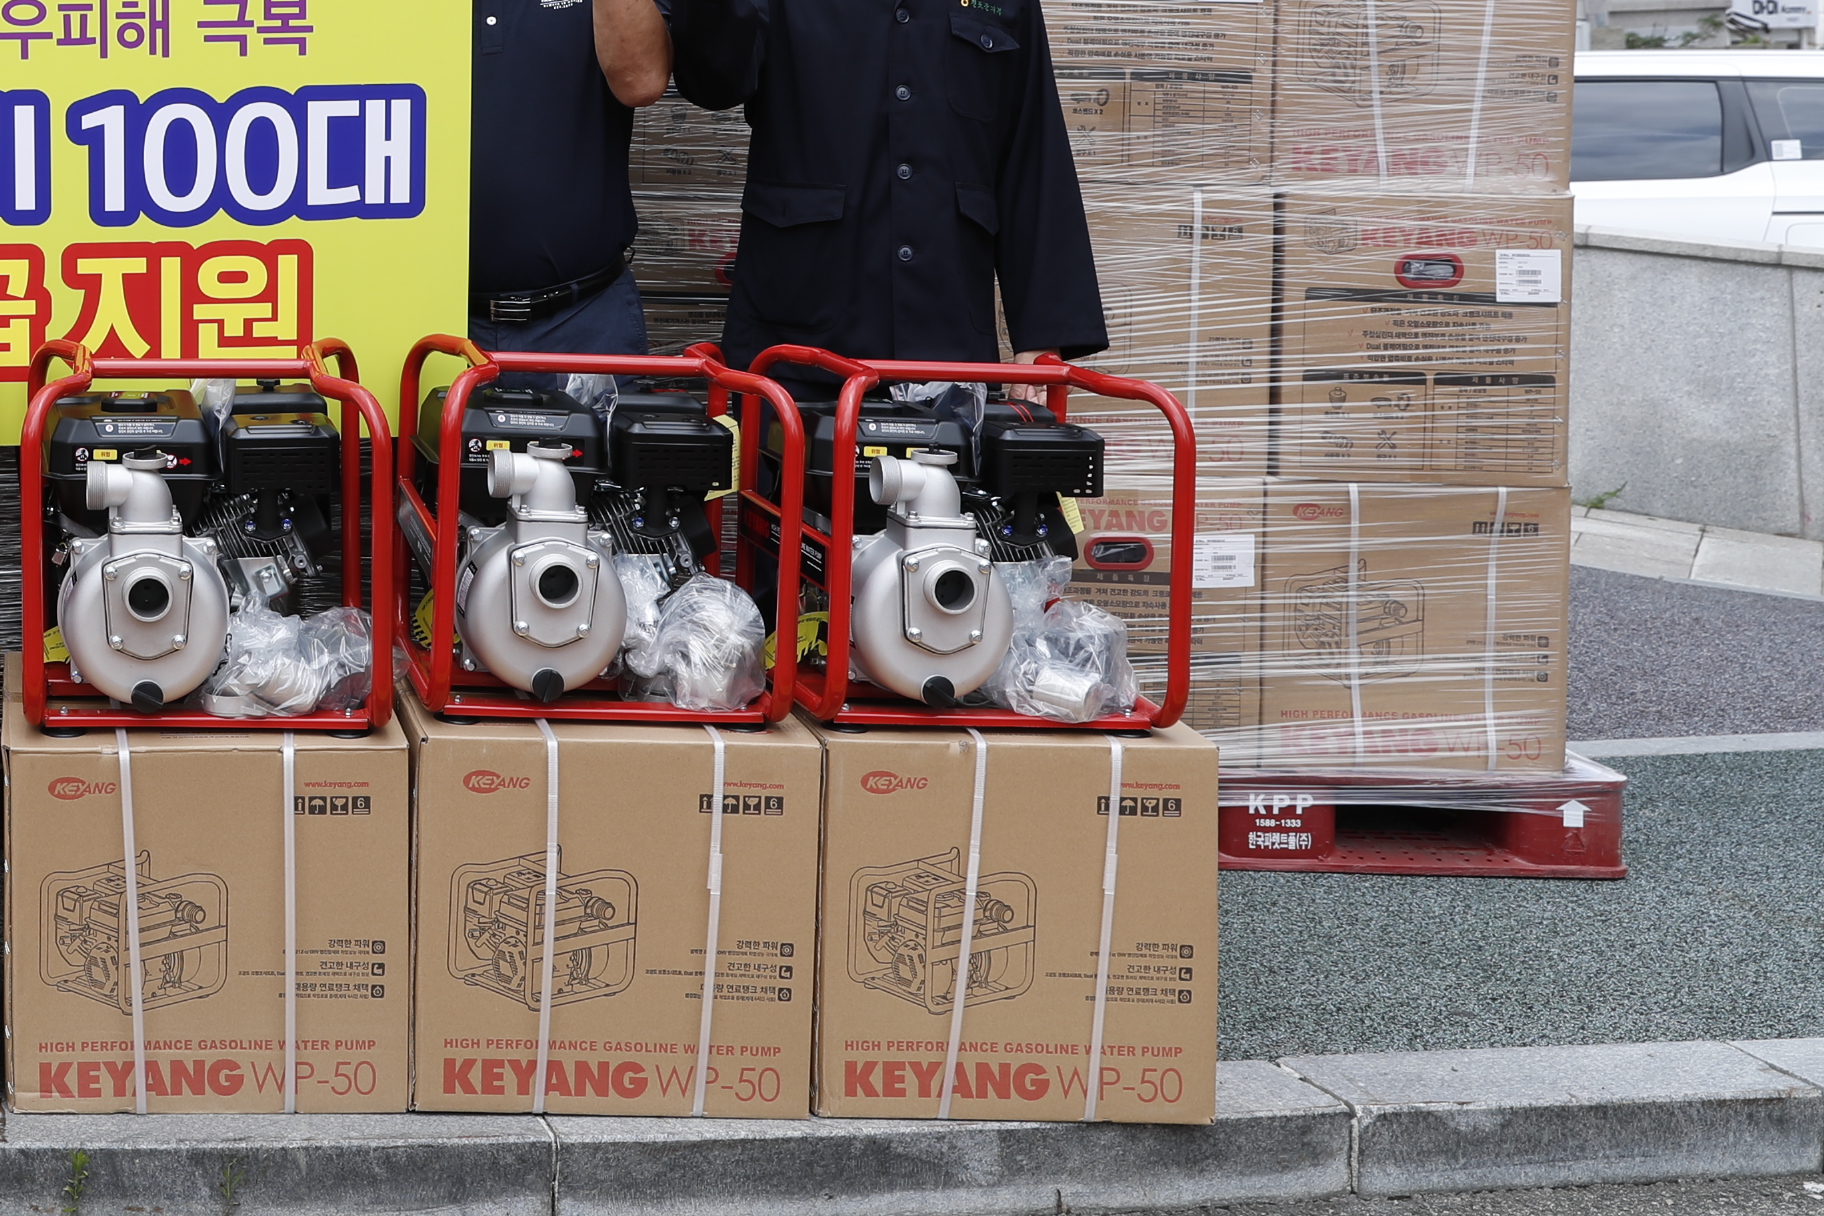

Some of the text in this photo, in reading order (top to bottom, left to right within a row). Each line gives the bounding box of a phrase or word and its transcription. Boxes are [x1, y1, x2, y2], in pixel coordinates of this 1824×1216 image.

[79, 97, 412, 216] 100대
[1291, 145, 1448, 176] KEYANG
[1361, 228, 1554, 251] KEYANG WP-50
[75, 253, 300, 360] 지원
[1083, 509, 1169, 532] YANG
[1295, 502, 1344, 520] KEYANG
[1280, 710, 1309, 719] HIGH
[50, 779, 116, 798] KEYANG
[304, 781, 369, 790] www.keyang.com
[465, 772, 531, 792] KEYANG
[863, 773, 928, 792] KEYANG
[1255, 818, 1302, 827] 1588-1333
[328, 940, 370, 948] 강력한 파워
[320, 961, 369, 970] 견고한 내구성
[38, 1041, 76, 1053] HIGH
[198, 1039, 273, 1051] GASOLINE
[334, 1039, 377, 1051] PUMP
[443, 1038, 482, 1049] HIGH
[603, 1040, 679, 1054] GASOLINE
[683, 1044, 736, 1056] WTER
[740, 1045, 783, 1057] PUMP
[844, 1040, 882, 1052] HIGH
[886, 1040, 999, 1053] PERFORANCE
[1004, 1042, 1079, 1055] GASOLINE
[1141, 1046, 1184, 1058] PUMP
[40, 1059, 376, 1098] KEYANG WP-50
[443, 1058, 780, 1102] KEYANG WP-50
[845, 1061, 1183, 1103] KEYANG WP-50
